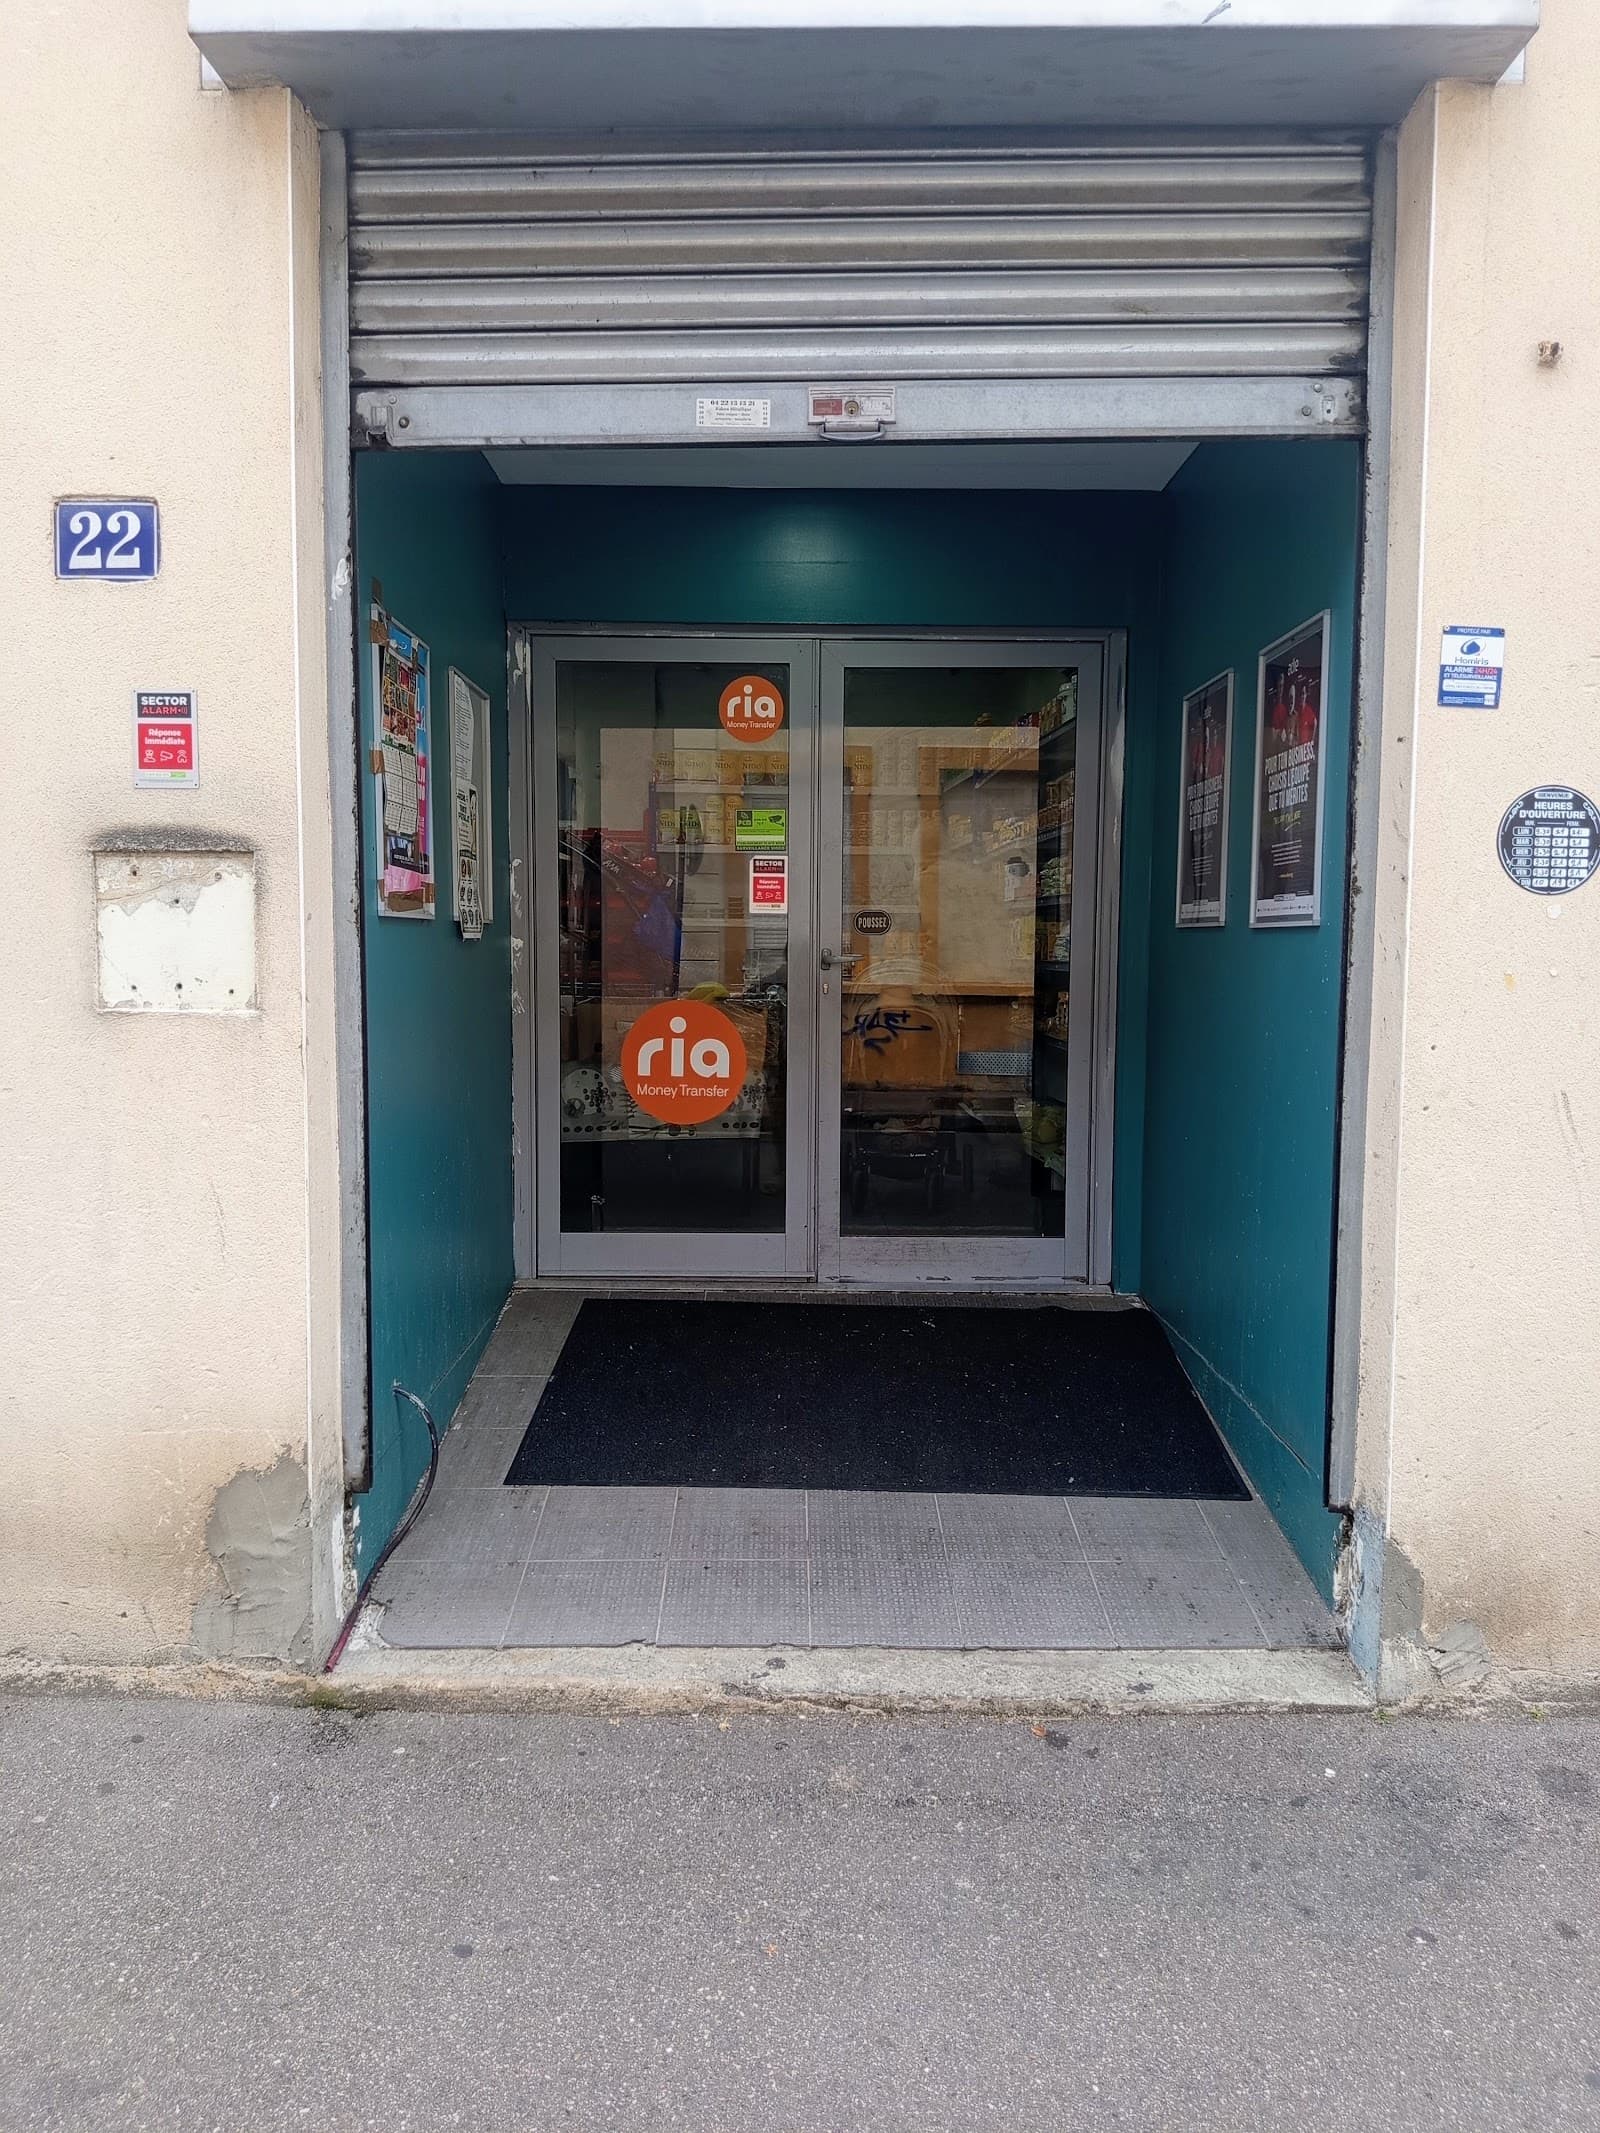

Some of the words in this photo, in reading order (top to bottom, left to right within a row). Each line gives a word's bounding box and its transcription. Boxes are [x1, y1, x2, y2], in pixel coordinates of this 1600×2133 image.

[69, 510, 142, 570] 22
[1454, 656, 1489, 666] Homiris
[1444, 666, 1474, 674] ALARME
[140, 696, 188, 706] SECTOR
[727, 684, 776, 718] ria
[141, 706, 178, 715] ALARM
[726, 720, 749, 730] Money
[749, 720, 776, 729] Transfer
[148, 728, 182, 739] Réponse
[1534, 801, 1573, 810] HEURES
[1519, 810, 1586, 820] D'OUVERTURE
[1517, 827, 1530, 835] LUN
[858, 917, 887, 928] POUSSEZ
[637, 1016, 730, 1079] ria
[637, 1083, 679, 1100] Money
[679, 1083, 730, 1098] Transfer
